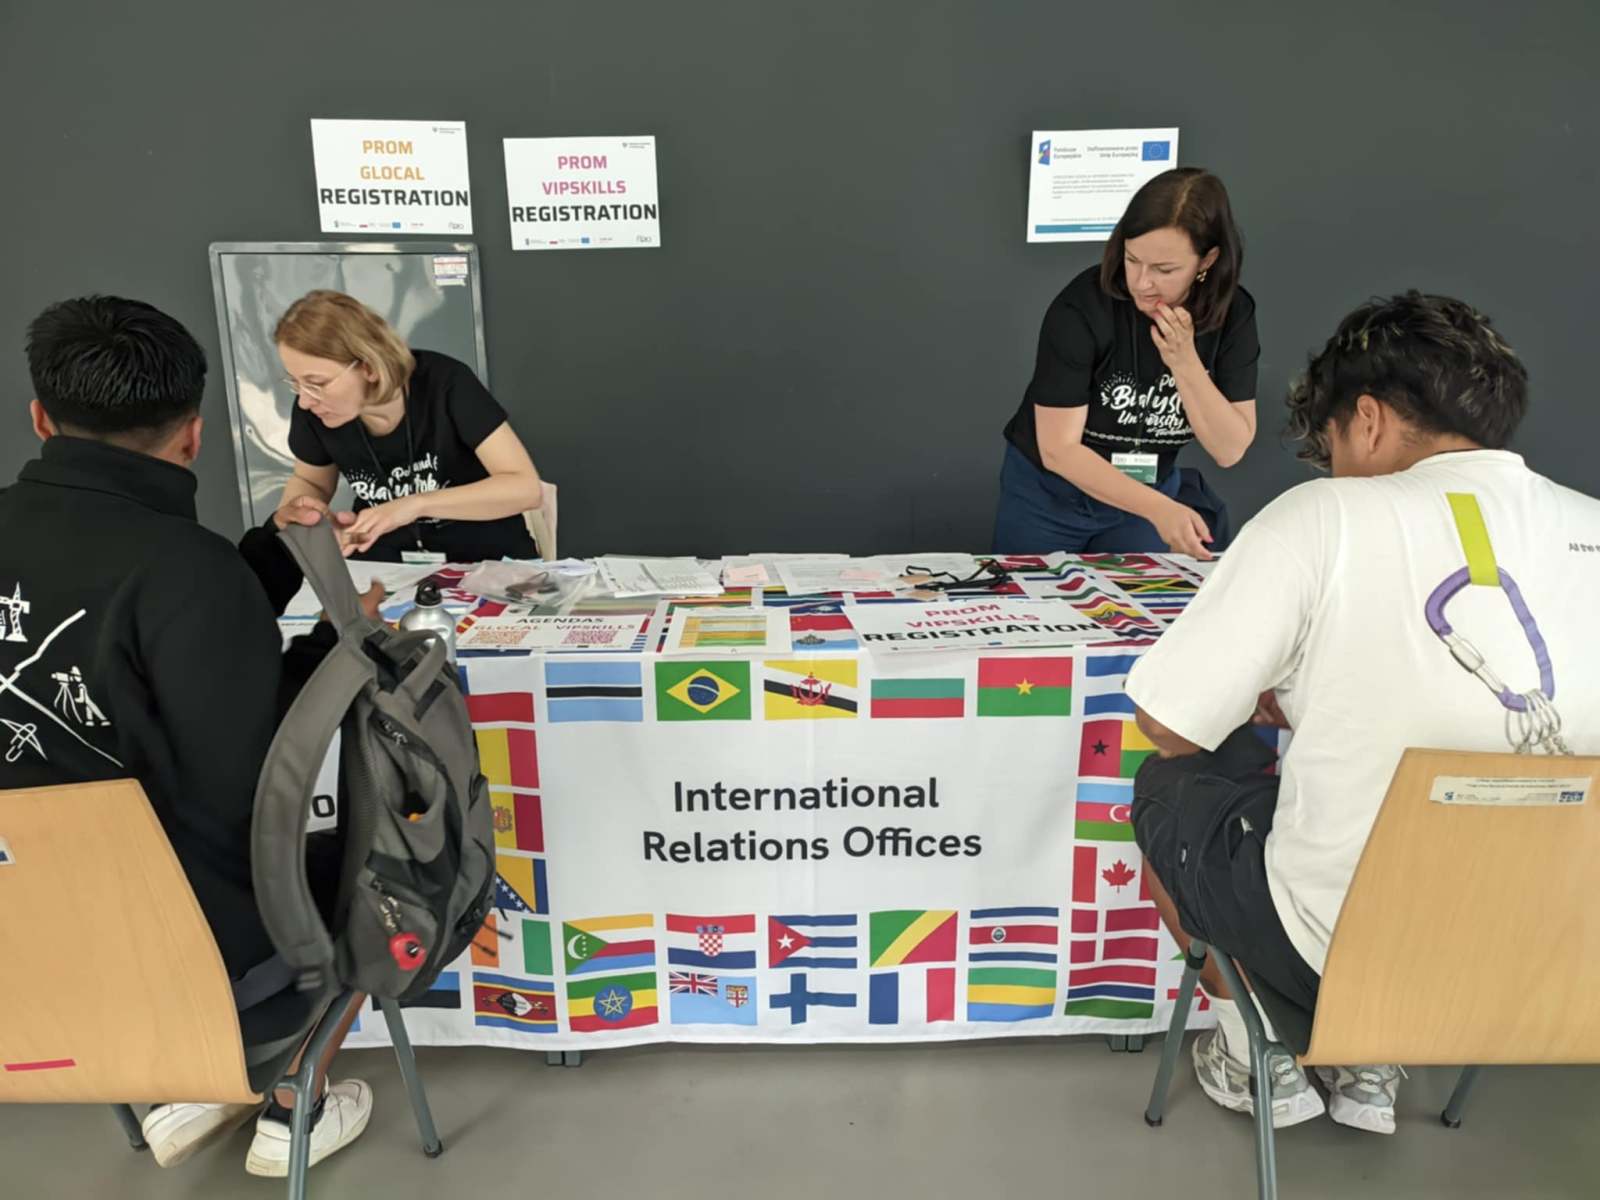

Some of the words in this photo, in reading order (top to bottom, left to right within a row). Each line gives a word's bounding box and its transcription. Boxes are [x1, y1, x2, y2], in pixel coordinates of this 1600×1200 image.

[363, 140, 413, 154] PROM
[557, 155, 607, 169] PROM
[360, 166, 425, 180] GLOCAL
[542, 180, 627, 195] VIPSKILLS
[320, 188, 469, 206] REGISTRATION
[512, 204, 657, 222] REGISTRATION
[925, 604, 1001, 617] PROM
[906, 614, 1041, 628] VIPSKILLS
[862, 622, 1102, 642] REGISTRATION
[674, 777, 940, 812] International
[643, 830, 830, 863] Relations
[842, 826, 983, 858] Offices
